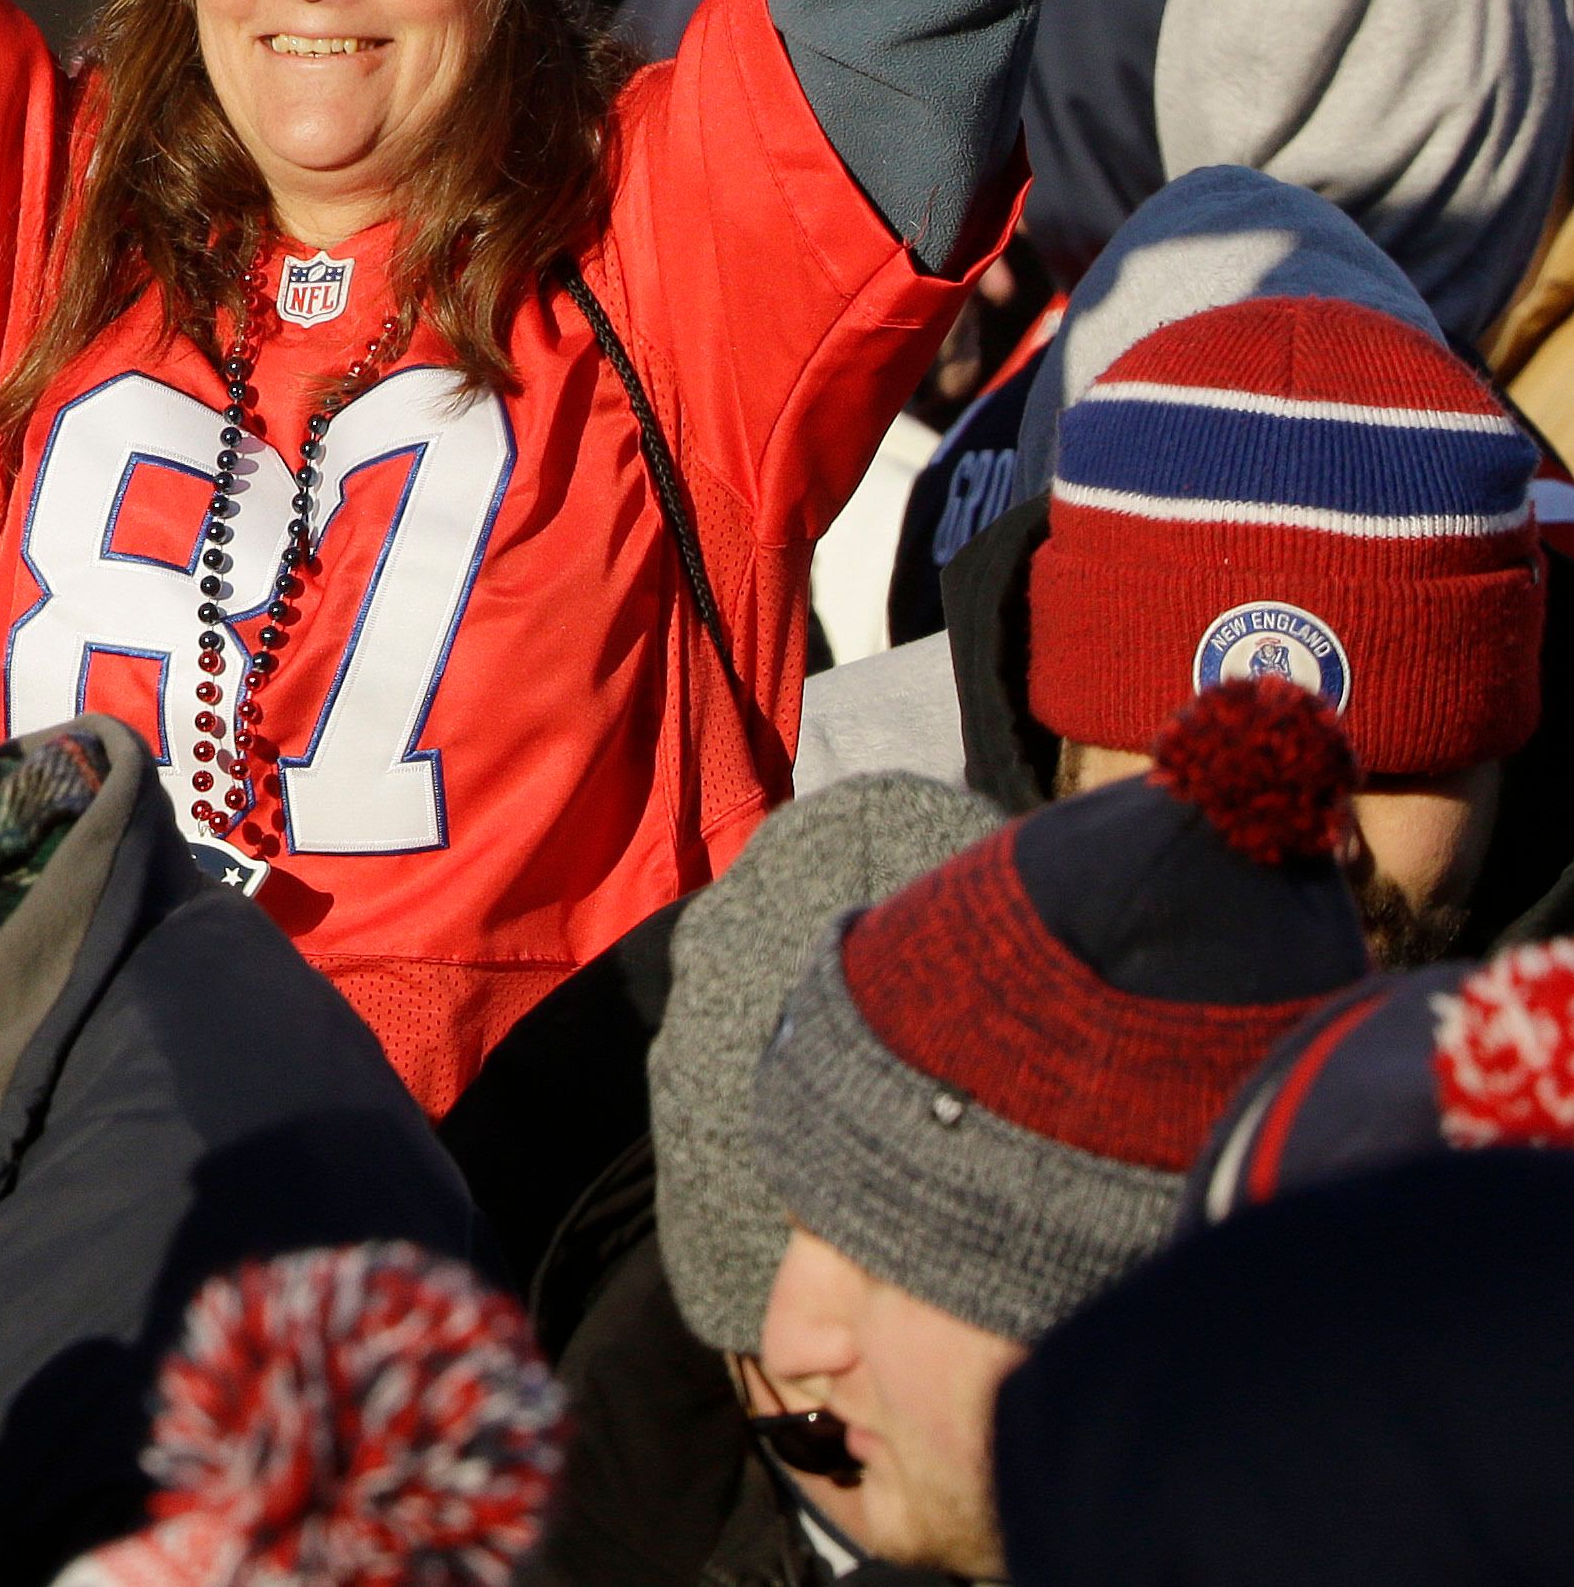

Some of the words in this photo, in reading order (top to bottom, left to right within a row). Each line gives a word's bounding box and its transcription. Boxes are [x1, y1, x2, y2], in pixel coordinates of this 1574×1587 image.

[289, 285, 334, 315] NFL
[4, 362, 518, 857] 87
[1210, 616, 1249, 652] NEW
[1250, 610, 1332, 659] ENGLAND
